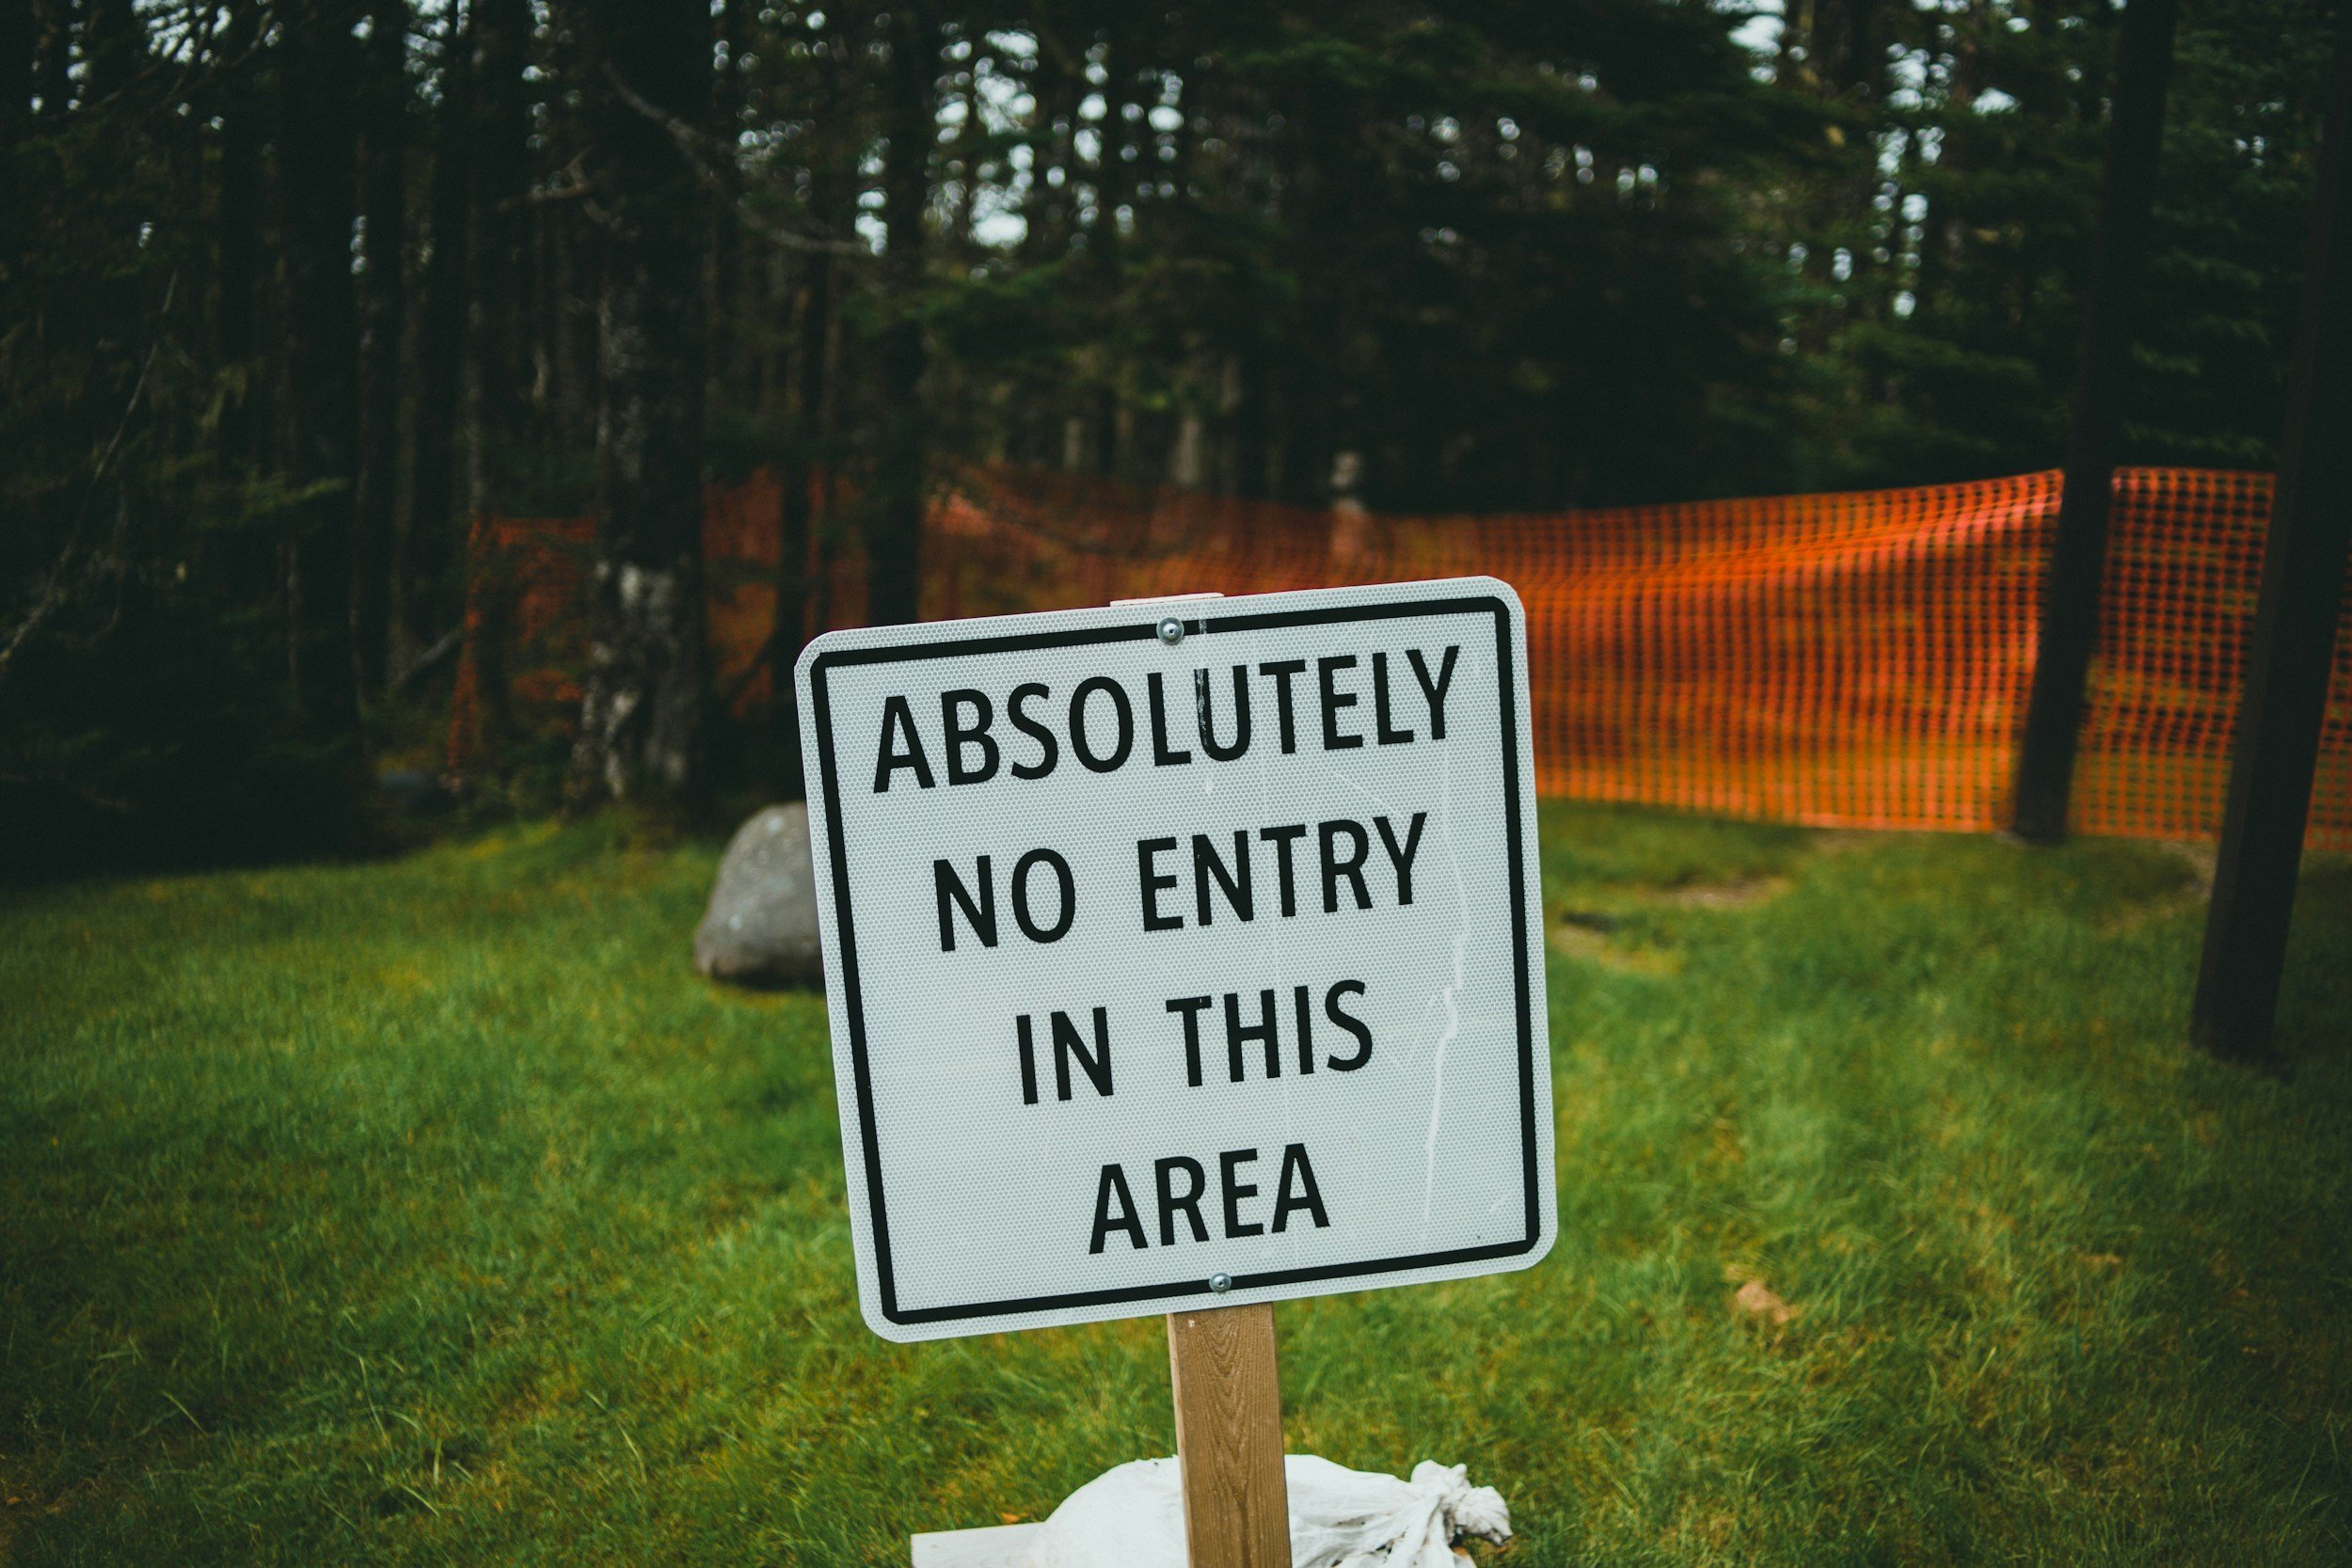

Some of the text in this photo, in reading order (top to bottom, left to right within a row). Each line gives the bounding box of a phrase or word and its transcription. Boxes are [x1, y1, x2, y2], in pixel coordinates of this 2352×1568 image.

[873, 644, 1460, 794] ABSOLUTELY
[933, 811, 1428, 952] NO ENTRY
[1015, 979, 1374, 1106] IN THIS
[1089, 1142, 1331, 1255] AREA
